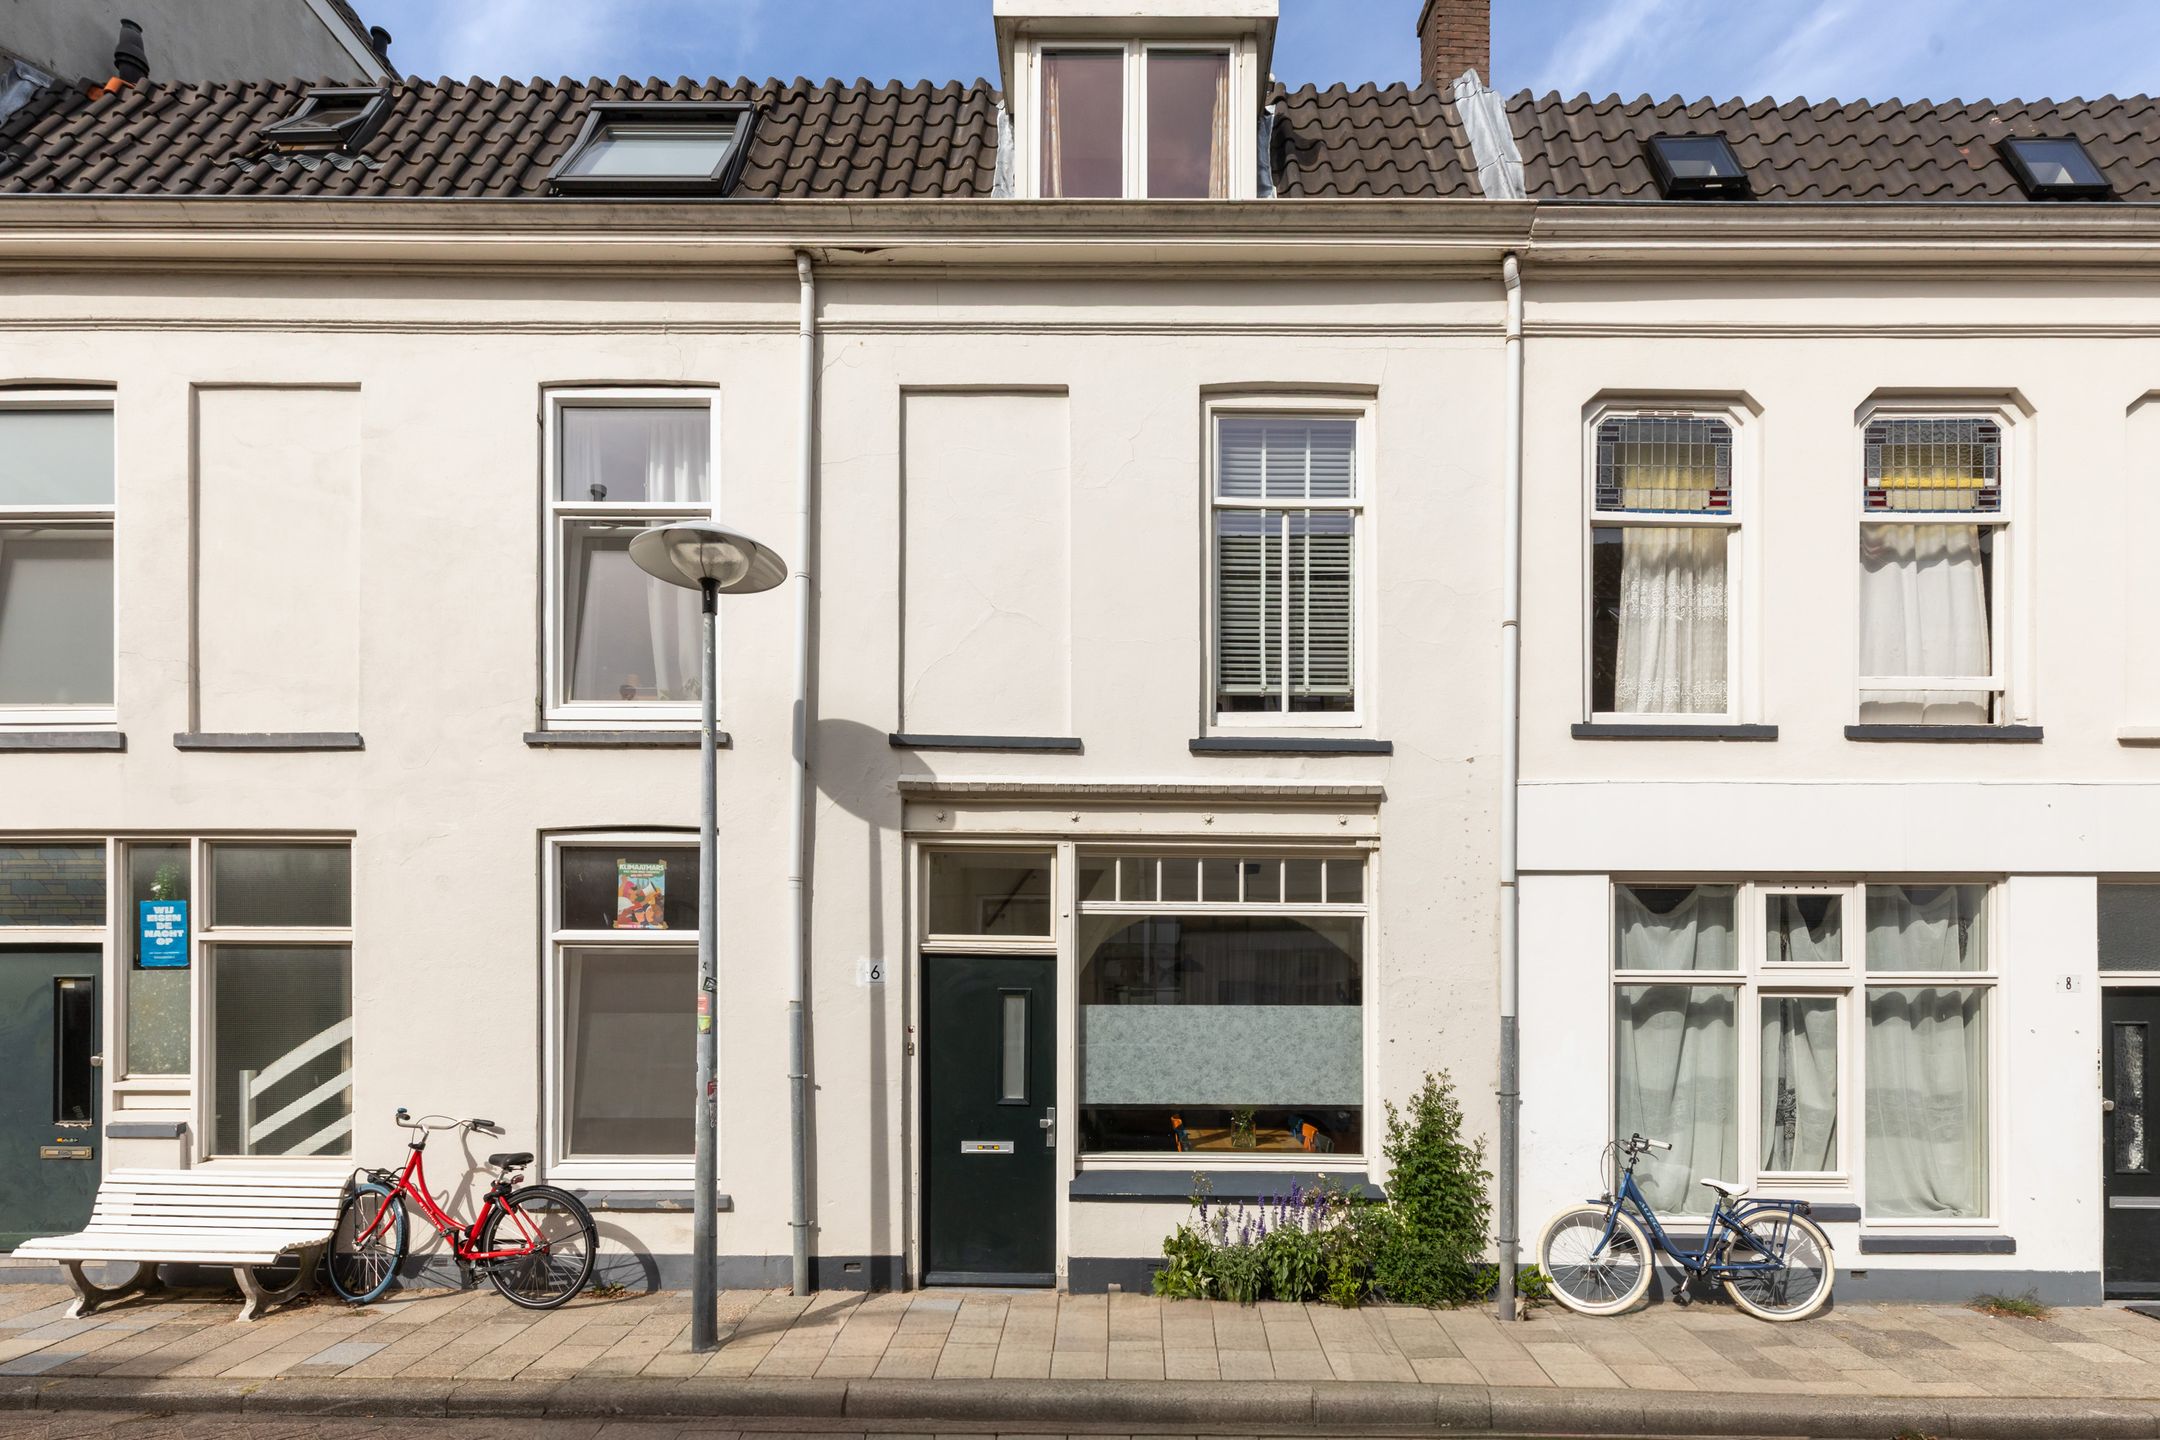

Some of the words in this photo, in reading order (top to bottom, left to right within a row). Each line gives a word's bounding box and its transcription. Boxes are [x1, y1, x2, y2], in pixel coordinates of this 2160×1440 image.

[156, 922, 173, 930] DE
[144, 930, 184, 938] NACHT
[871, 964, 880, 980] 6
[2065, 976, 2072, 990] 8
